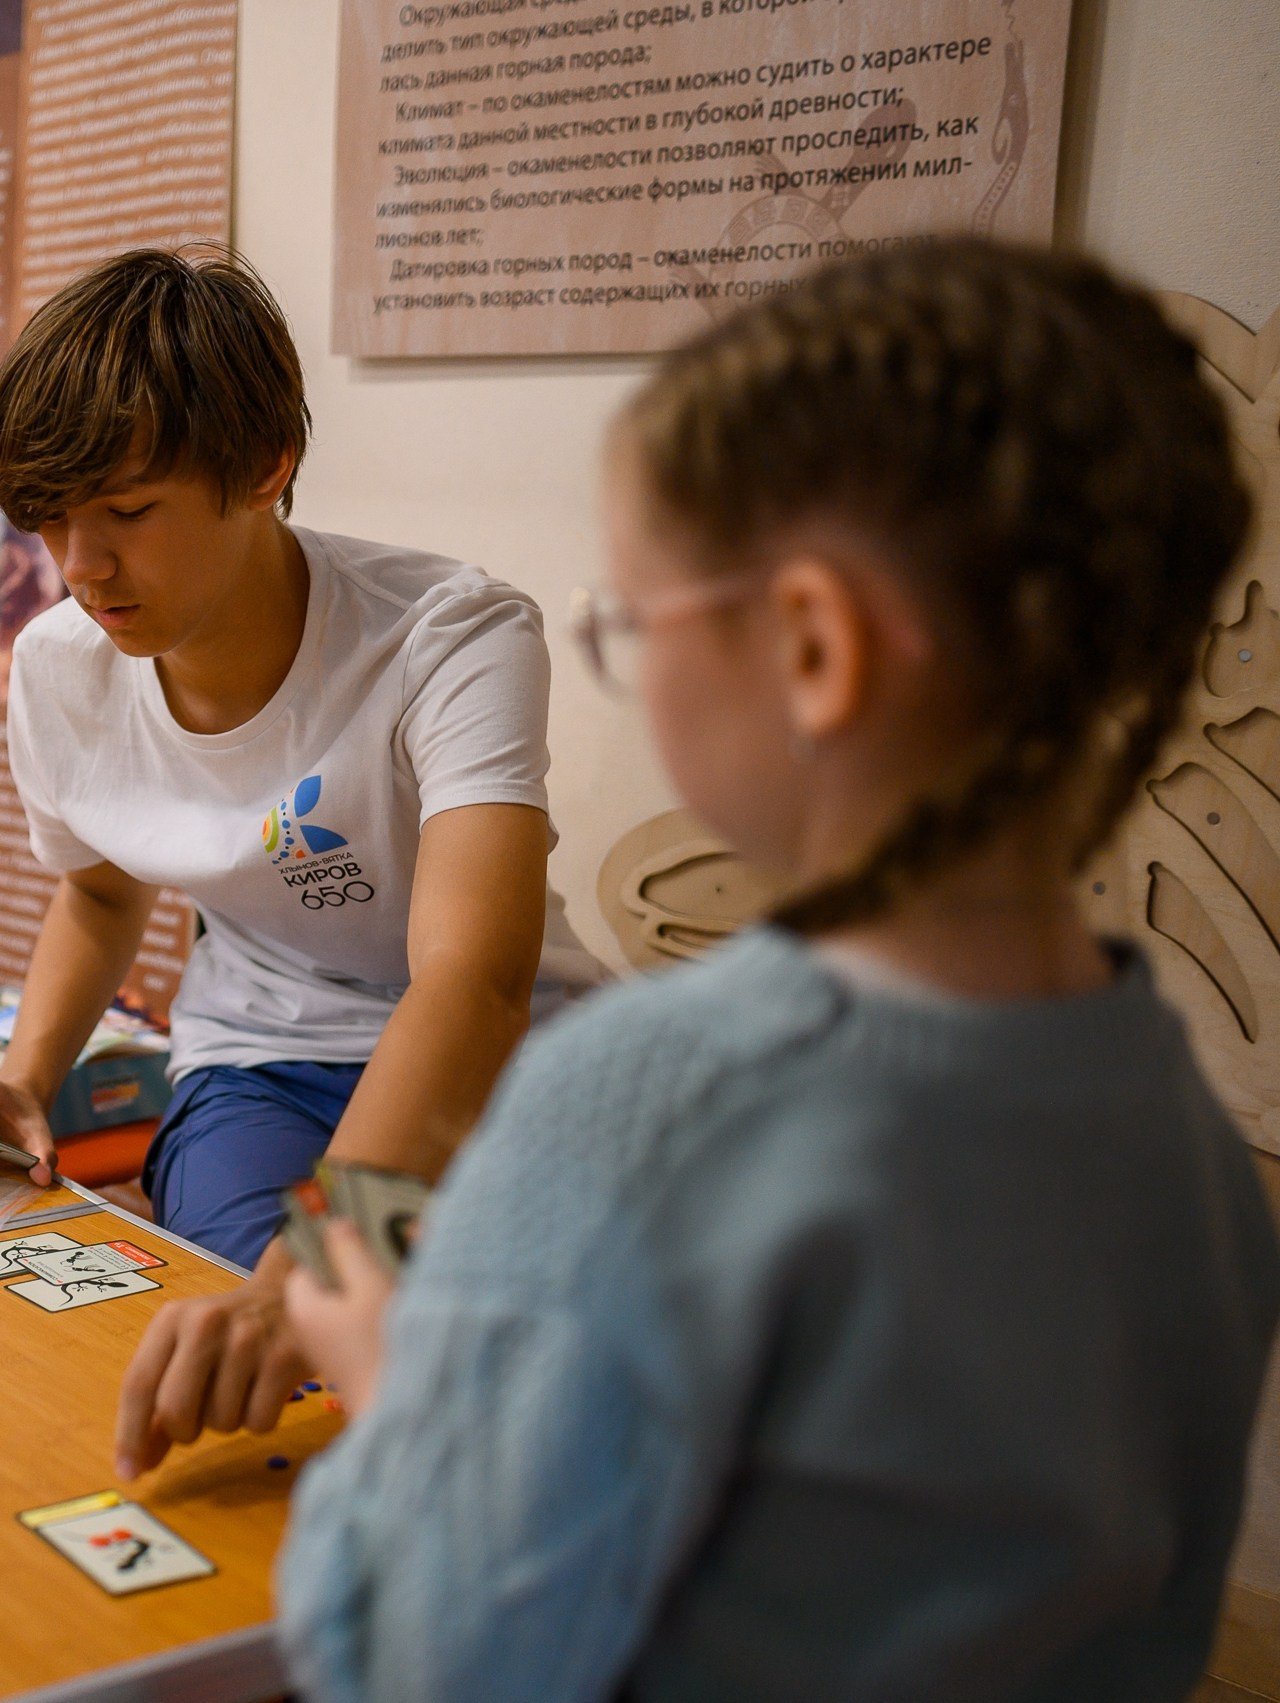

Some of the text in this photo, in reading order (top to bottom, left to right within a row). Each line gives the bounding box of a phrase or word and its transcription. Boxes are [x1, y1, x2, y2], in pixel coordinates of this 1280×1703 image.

[451, 34, 484, 51] тип
[487, 10, 619, 49] окружающей
[623, 4, 695, 32] среды,
[719, 0, 810, 15] котор
[396, 98, 464, 123] Климат
[482, 96, 506, 112] по
[510, 76, 670, 111] окаменелостям
[675, 68, 751, 93] можно
[756, 56, 834, 87] судить
[840, 53, 855, 72] о
[860, 36, 992, 71] характере
[495, 54, 565, 81] горная
[569, 43, 653, 71] порода;
[457, 121, 529, 150] данной
[533, 113, 640, 142] местности
[645, 114, 658, 130] в
[663, 97, 764, 132] глубокой
[768, 87, 904, 121] древности;
[507, 146, 652, 177] окаменелости
[657, 136, 775, 164] позволяют
[780, 119, 929, 155] проследить,
[936, 115, 979, 137] как
[490, 181, 641, 212] биологические
[647, 174, 723, 204] формы
[729, 174, 755, 192] на
[760, 160, 908, 195] протяжении
[912, 156, 974, 178] мил-
[493, 252, 565, 279] горных
[568, 247, 632, 273] пород
[653, 239, 813, 268] окаменелости
[480, 286, 555, 311] возраст
[559, 278, 690, 308] содержащих
[694, 281, 720, 298] их
[283, 862, 362, 888] КИРОВ
[301, 881, 375, 910] 650
